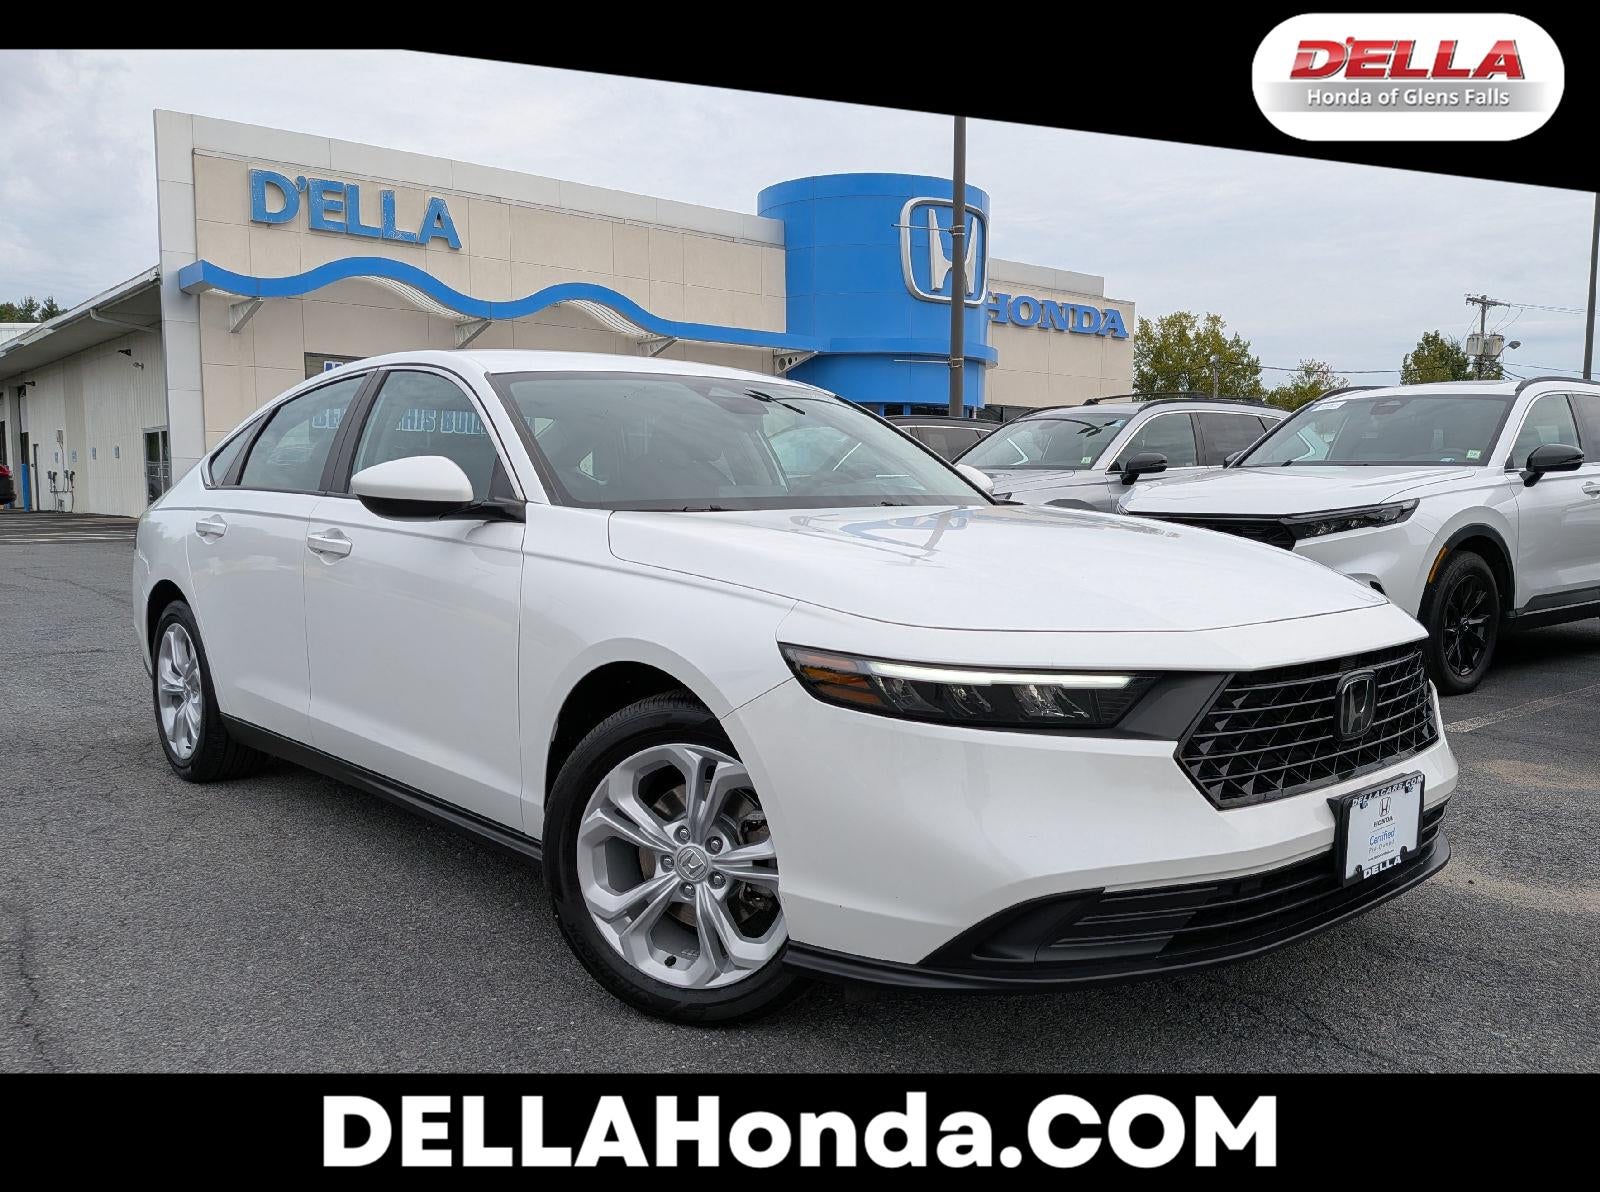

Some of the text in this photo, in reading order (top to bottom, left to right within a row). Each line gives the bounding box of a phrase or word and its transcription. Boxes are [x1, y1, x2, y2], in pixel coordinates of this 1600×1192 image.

[249, 169, 462, 249] D'ELLA
[987, 291, 1129, 339] HONDA
[1352, 774, 1424, 807] DELLACARS.COM
[1373, 816, 1393, 828] HONDA
[1369, 828, 1396, 846] Certified
[1363, 855, 1402, 879] DELLA
